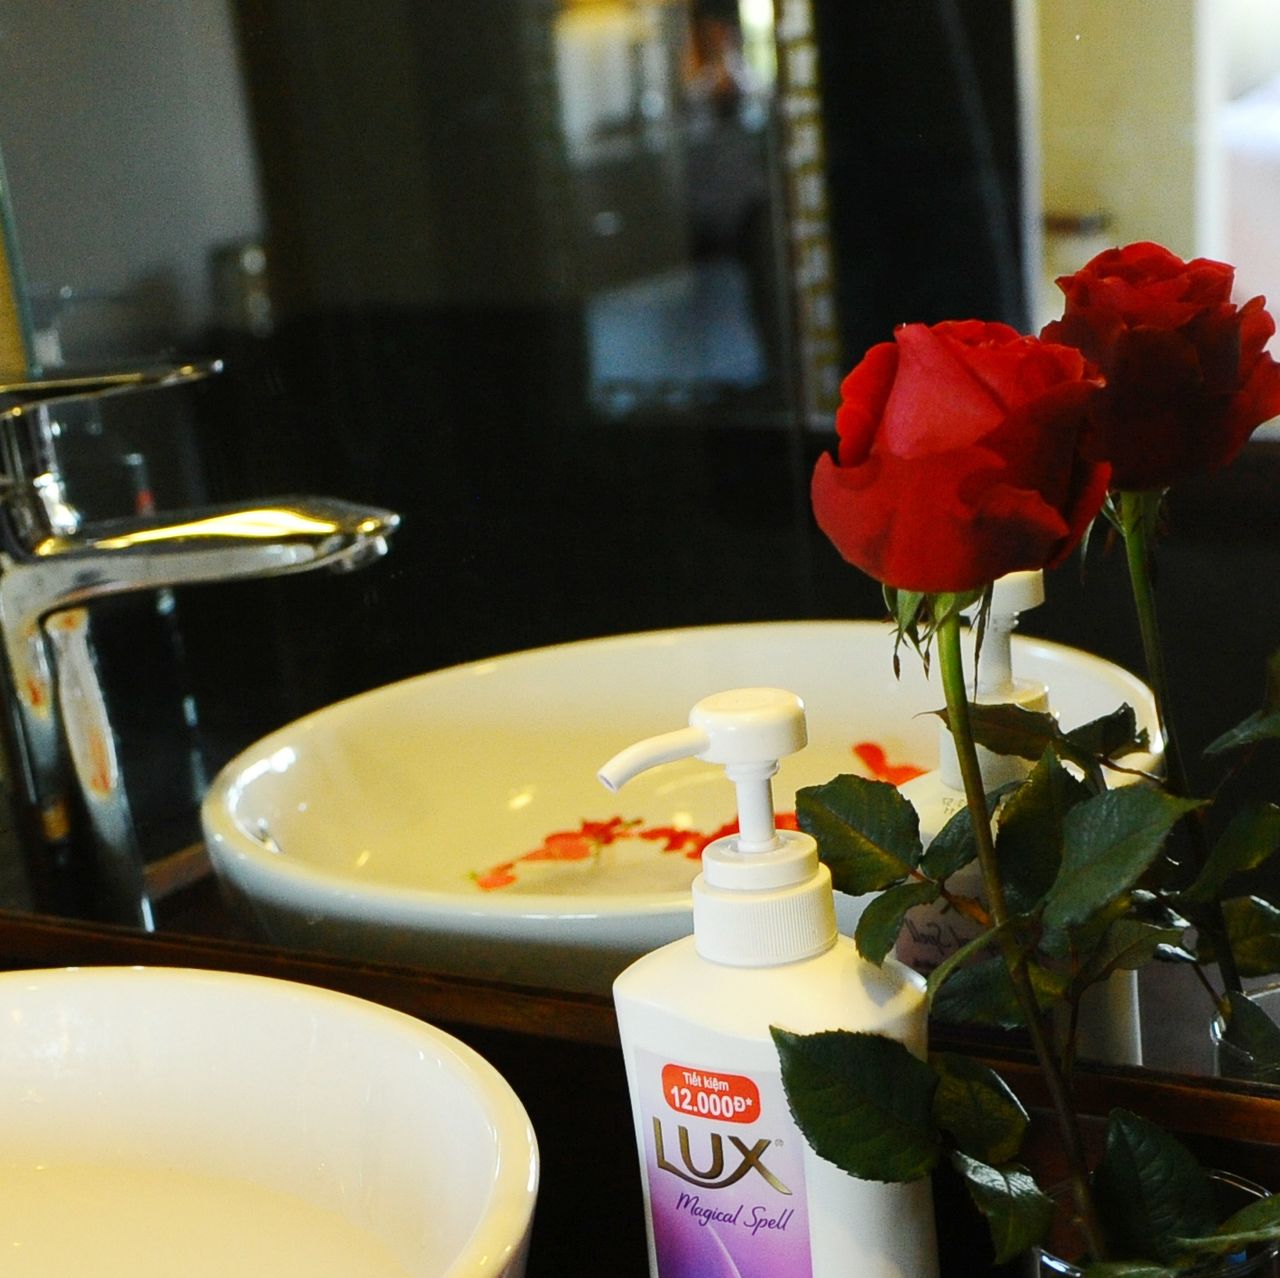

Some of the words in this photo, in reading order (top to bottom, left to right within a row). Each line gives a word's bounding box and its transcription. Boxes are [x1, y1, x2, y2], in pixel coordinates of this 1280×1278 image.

[682, 1071, 702, 1088] Tiết
[703, 1075, 730, 1092] kiệm
[652, 1116, 793, 1196] LUX
[675, 1192, 744, 1228] Magical
[743, 1206, 795, 1237] Spell
